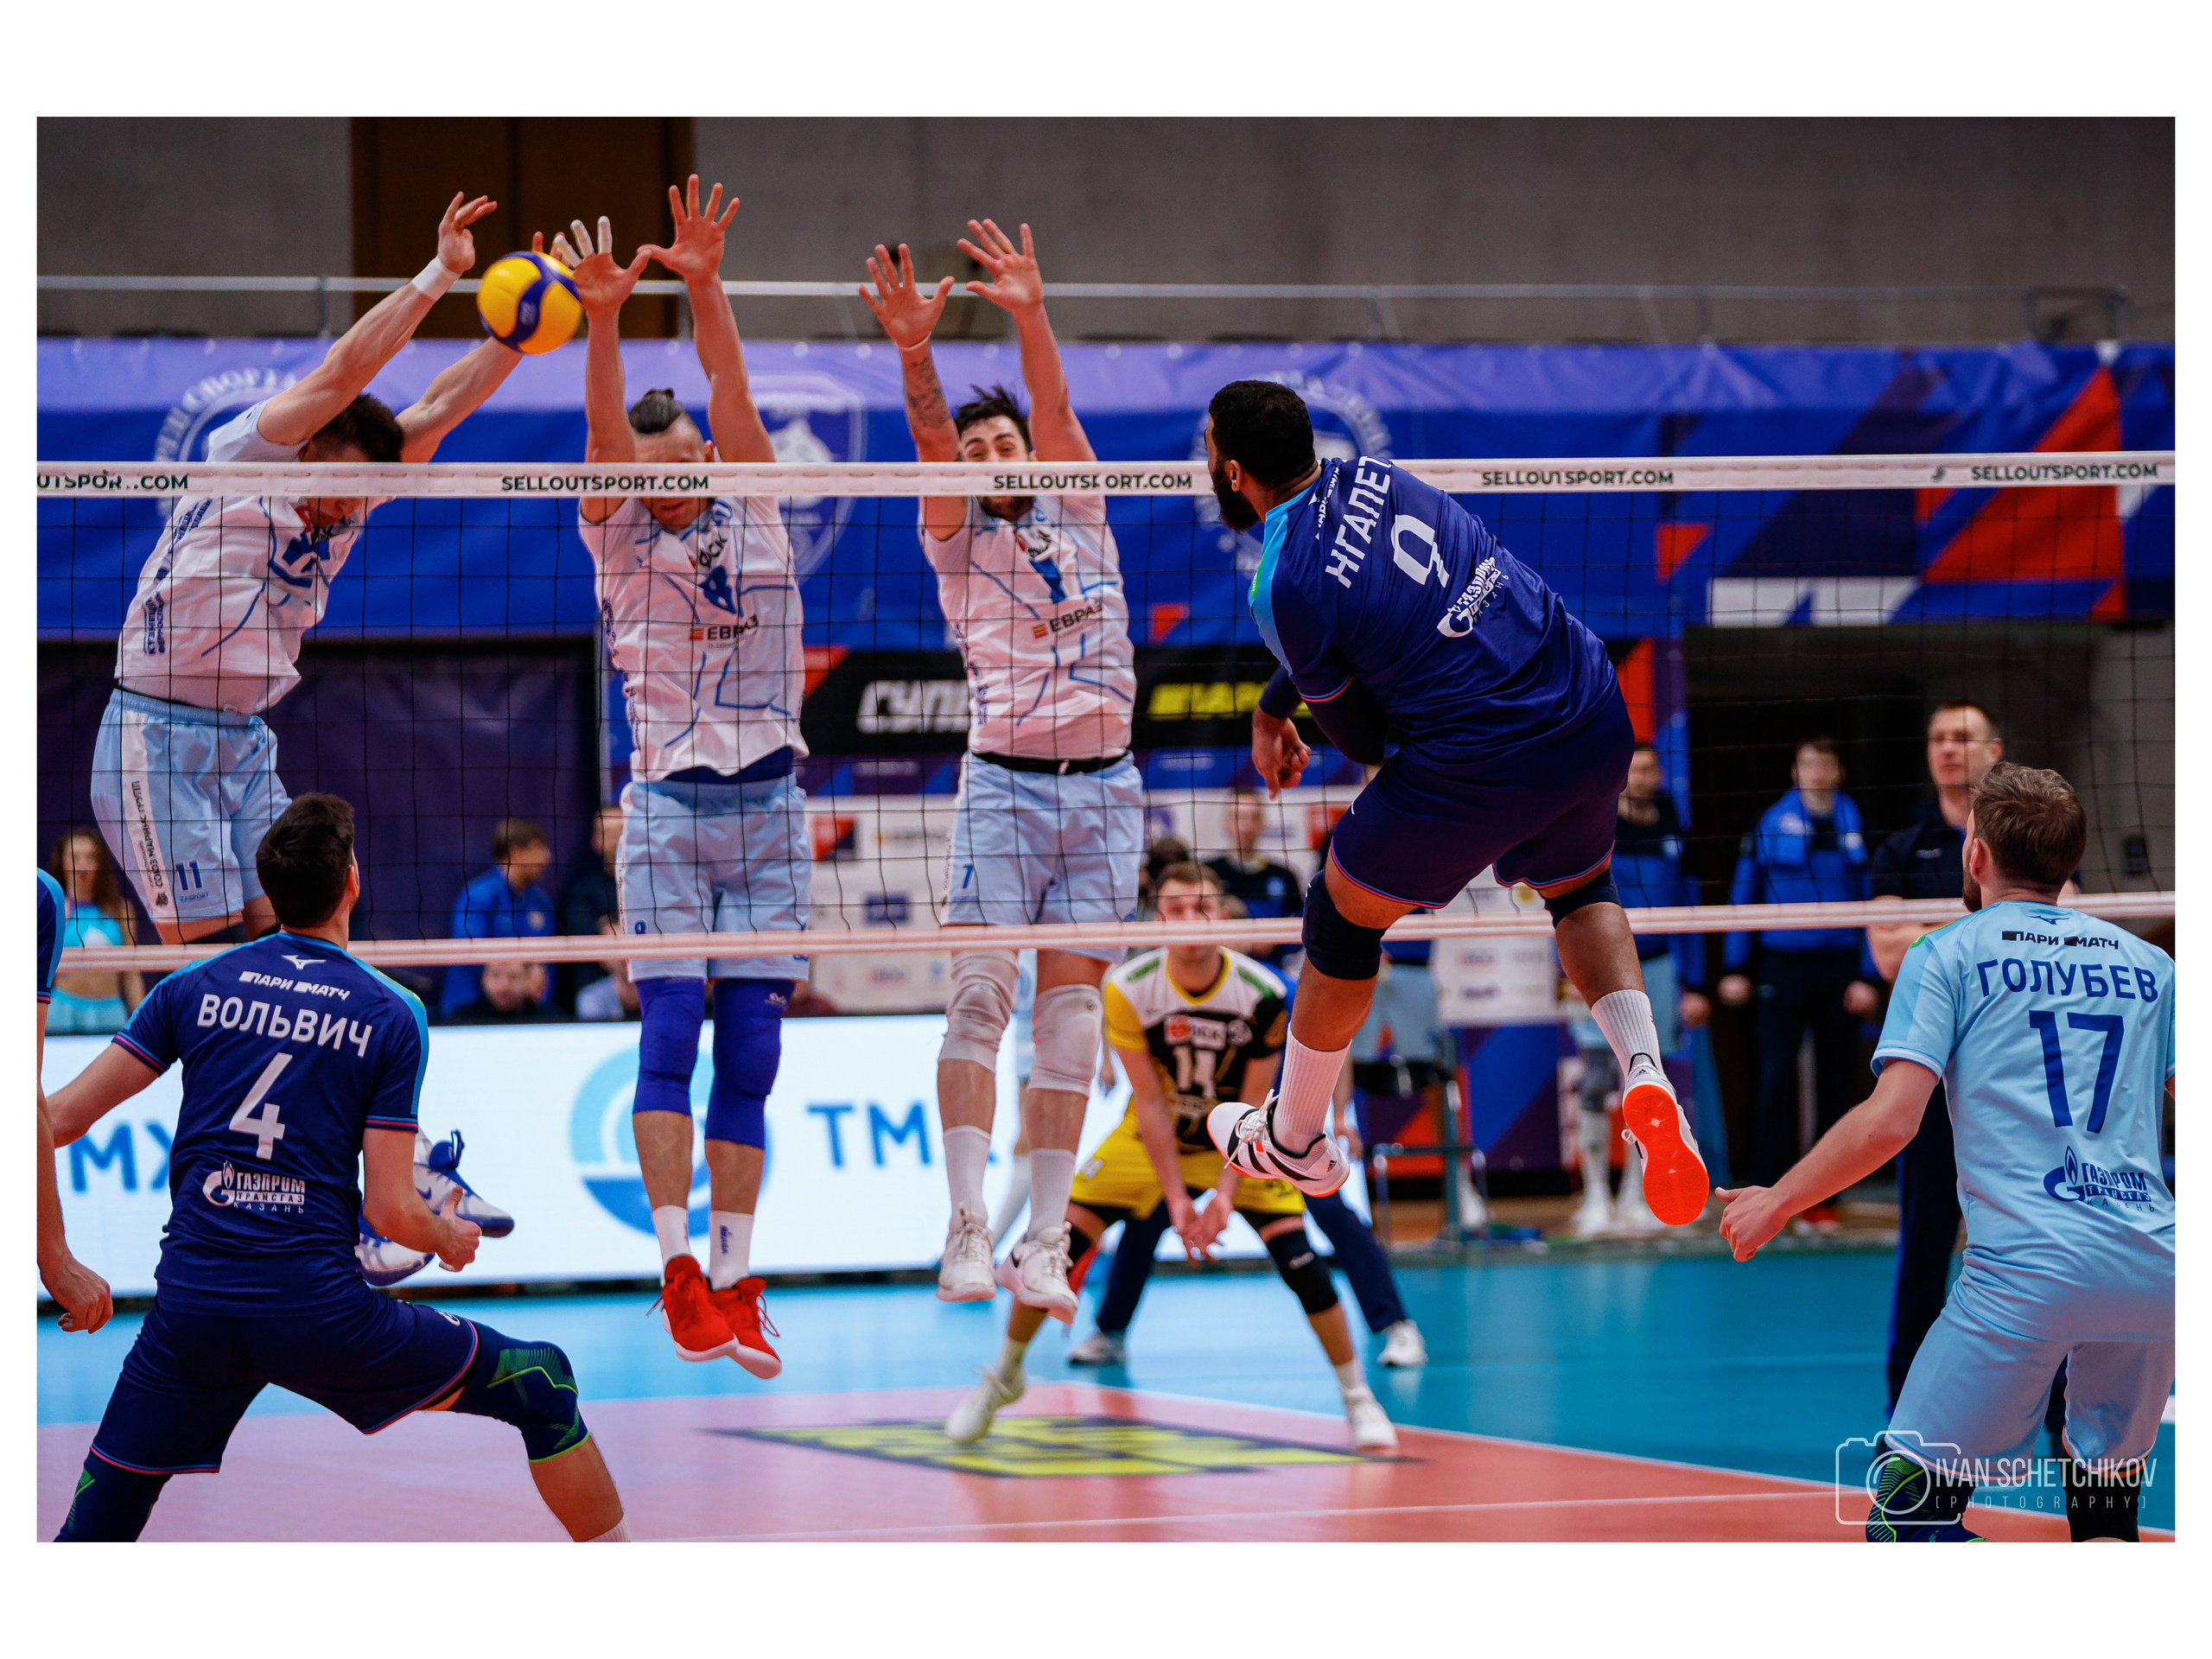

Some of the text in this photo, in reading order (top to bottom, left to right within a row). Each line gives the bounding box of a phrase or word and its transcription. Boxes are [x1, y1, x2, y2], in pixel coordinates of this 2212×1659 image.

[502, 475, 709, 492] SELLOUTSPORT.COM
[1972, 464, 2158, 481] SELLOUTSPORT.COM
[1390, 514, 1450, 588] 9
[1049, 600, 1103, 632] ЕВРАЗ
[175, 861, 202, 891] 11
[2002, 931, 2120, 950] ПАРИ МАТЧ
[238, 970, 351, 1001] ПАРИ МАТЧ
[1976, 957, 2159, 1003] ГОЛУБЕВ
[196, 993, 373, 1058] ВОЛЬВИЧ
[2028, 1009, 2126, 1135] 17
[228, 1052, 293, 1160] 4
[806, 1099, 996, 1168] ТМ
[237, 1172, 306, 1194] ГАЗПРОМ
[2081, 1162, 2147, 1192] ГАЗПРОМ
[233, 1201, 304, 1214] КАЗАНЬ
[237, 1192, 303, 1204] ТРАНСГАЗ
[2086, 1185, 2152, 1203] ТРАНСГАЗ
